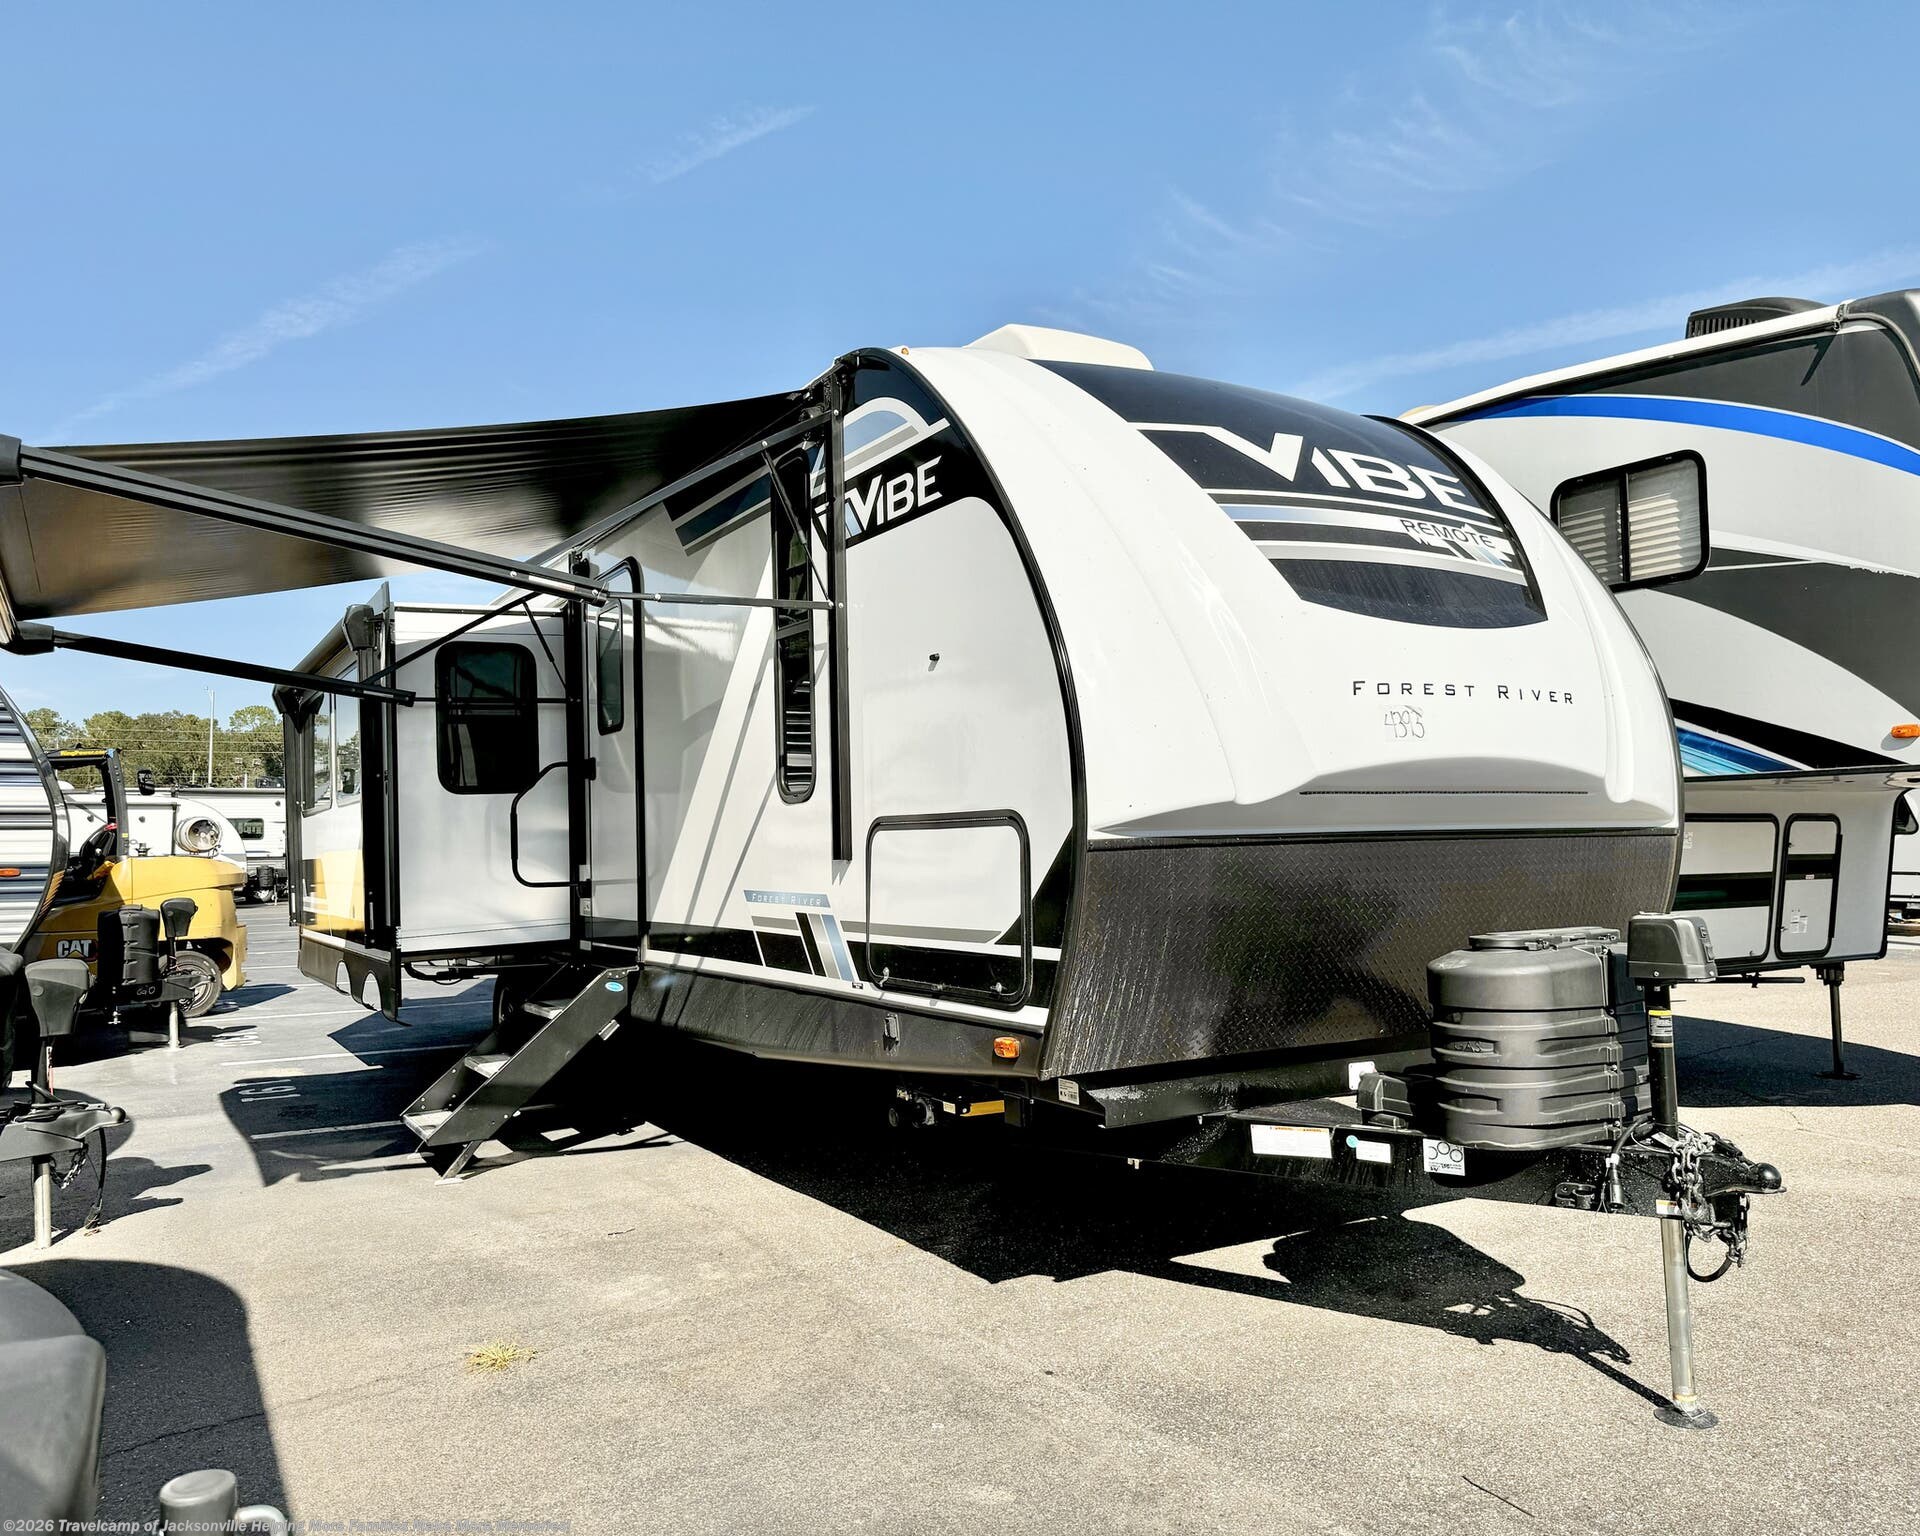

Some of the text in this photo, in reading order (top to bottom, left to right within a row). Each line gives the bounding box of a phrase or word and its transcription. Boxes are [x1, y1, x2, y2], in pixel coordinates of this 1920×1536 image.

[1200, 427, 1497, 520] VIBE
[844, 455, 943, 531] VIBE
[1400, 519, 1496, 549] REMOTE
[1352, 681, 1573, 704] FOREST RIVER
[57, 939, 92, 958] CAT
